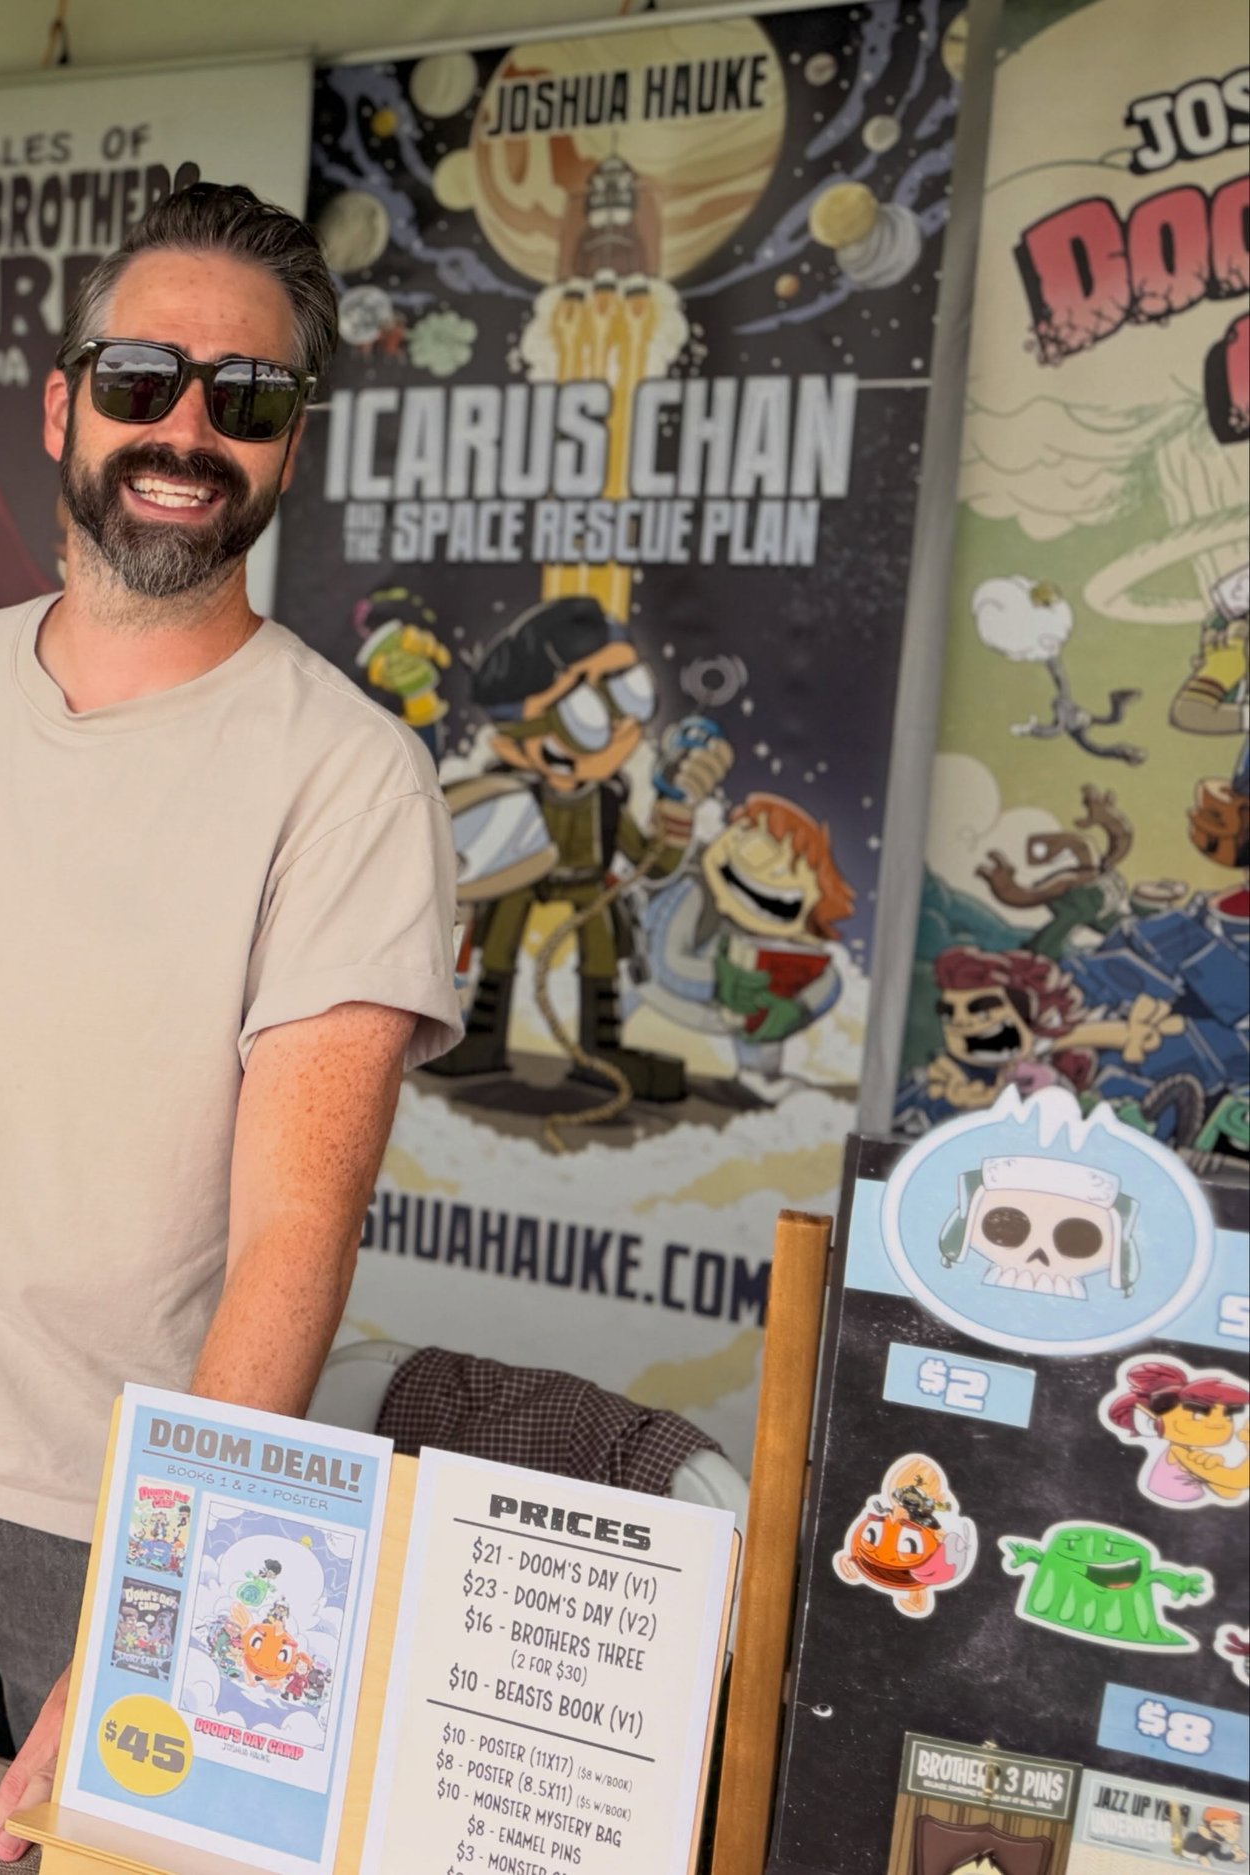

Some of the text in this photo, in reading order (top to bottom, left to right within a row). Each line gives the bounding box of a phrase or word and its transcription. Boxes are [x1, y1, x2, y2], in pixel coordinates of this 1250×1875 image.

[487, 54, 768, 137] JOSHUA HAUKE
[100, 123, 151, 161] OF
[324, 373, 858, 501] ICARUS CHAN
[343, 501, 821, 567] THE SPACE RESCUE PLAN
[918, 1356, 990, 1412] $2
[149, 1418, 363, 1493] DOOM DEAL!
[167, 1464, 215, 1484] BOOKS
[221, 1477, 227, 1487] 1
[232, 1480, 242, 1490] &
[247, 1484, 255, 1494] 2
[273, 1489, 329, 1511] POSTER
[489, 1493, 651, 1551] PRICES
[472, 1536, 658, 1605] $21 DOOM'S DAY (V1)
[463, 1569, 657, 1641] $23 DOOM'S DAY (V2)
[465, 1605, 646, 1671] $16 BROTHERS THREE
[511, 1649, 588, 1687] (2 FOR $30)
[449, 1662, 643, 1739] $10 BEASTS BOOK (V1)
[1136, 1699, 1213, 1755] $8
[105, 1720, 185, 1773] $45
[194, 1717, 304, 1760] DOOM'S DAY CAMP
[443, 1722, 633, 1793] $10 POSTER (11X17) ($8 W/BOOK)
[436, 1749, 632, 1822] $8 POSTER (8.5X11) ($5 W/BOOK)
[437, 1777, 622, 1848] $10 MONSTER MYSTERY BAG
[1004, 1766, 1020, 1793] 3
[1022, 1770, 1064, 1801] PINS
[1094, 1785, 1191, 1827] JAZZ UP YOR
[456, 1840, 475, 1862] $3
[488, 1852, 547, 1875] MONSTER
[467, 1814, 582, 1865] $8 ENAMEL PINS
